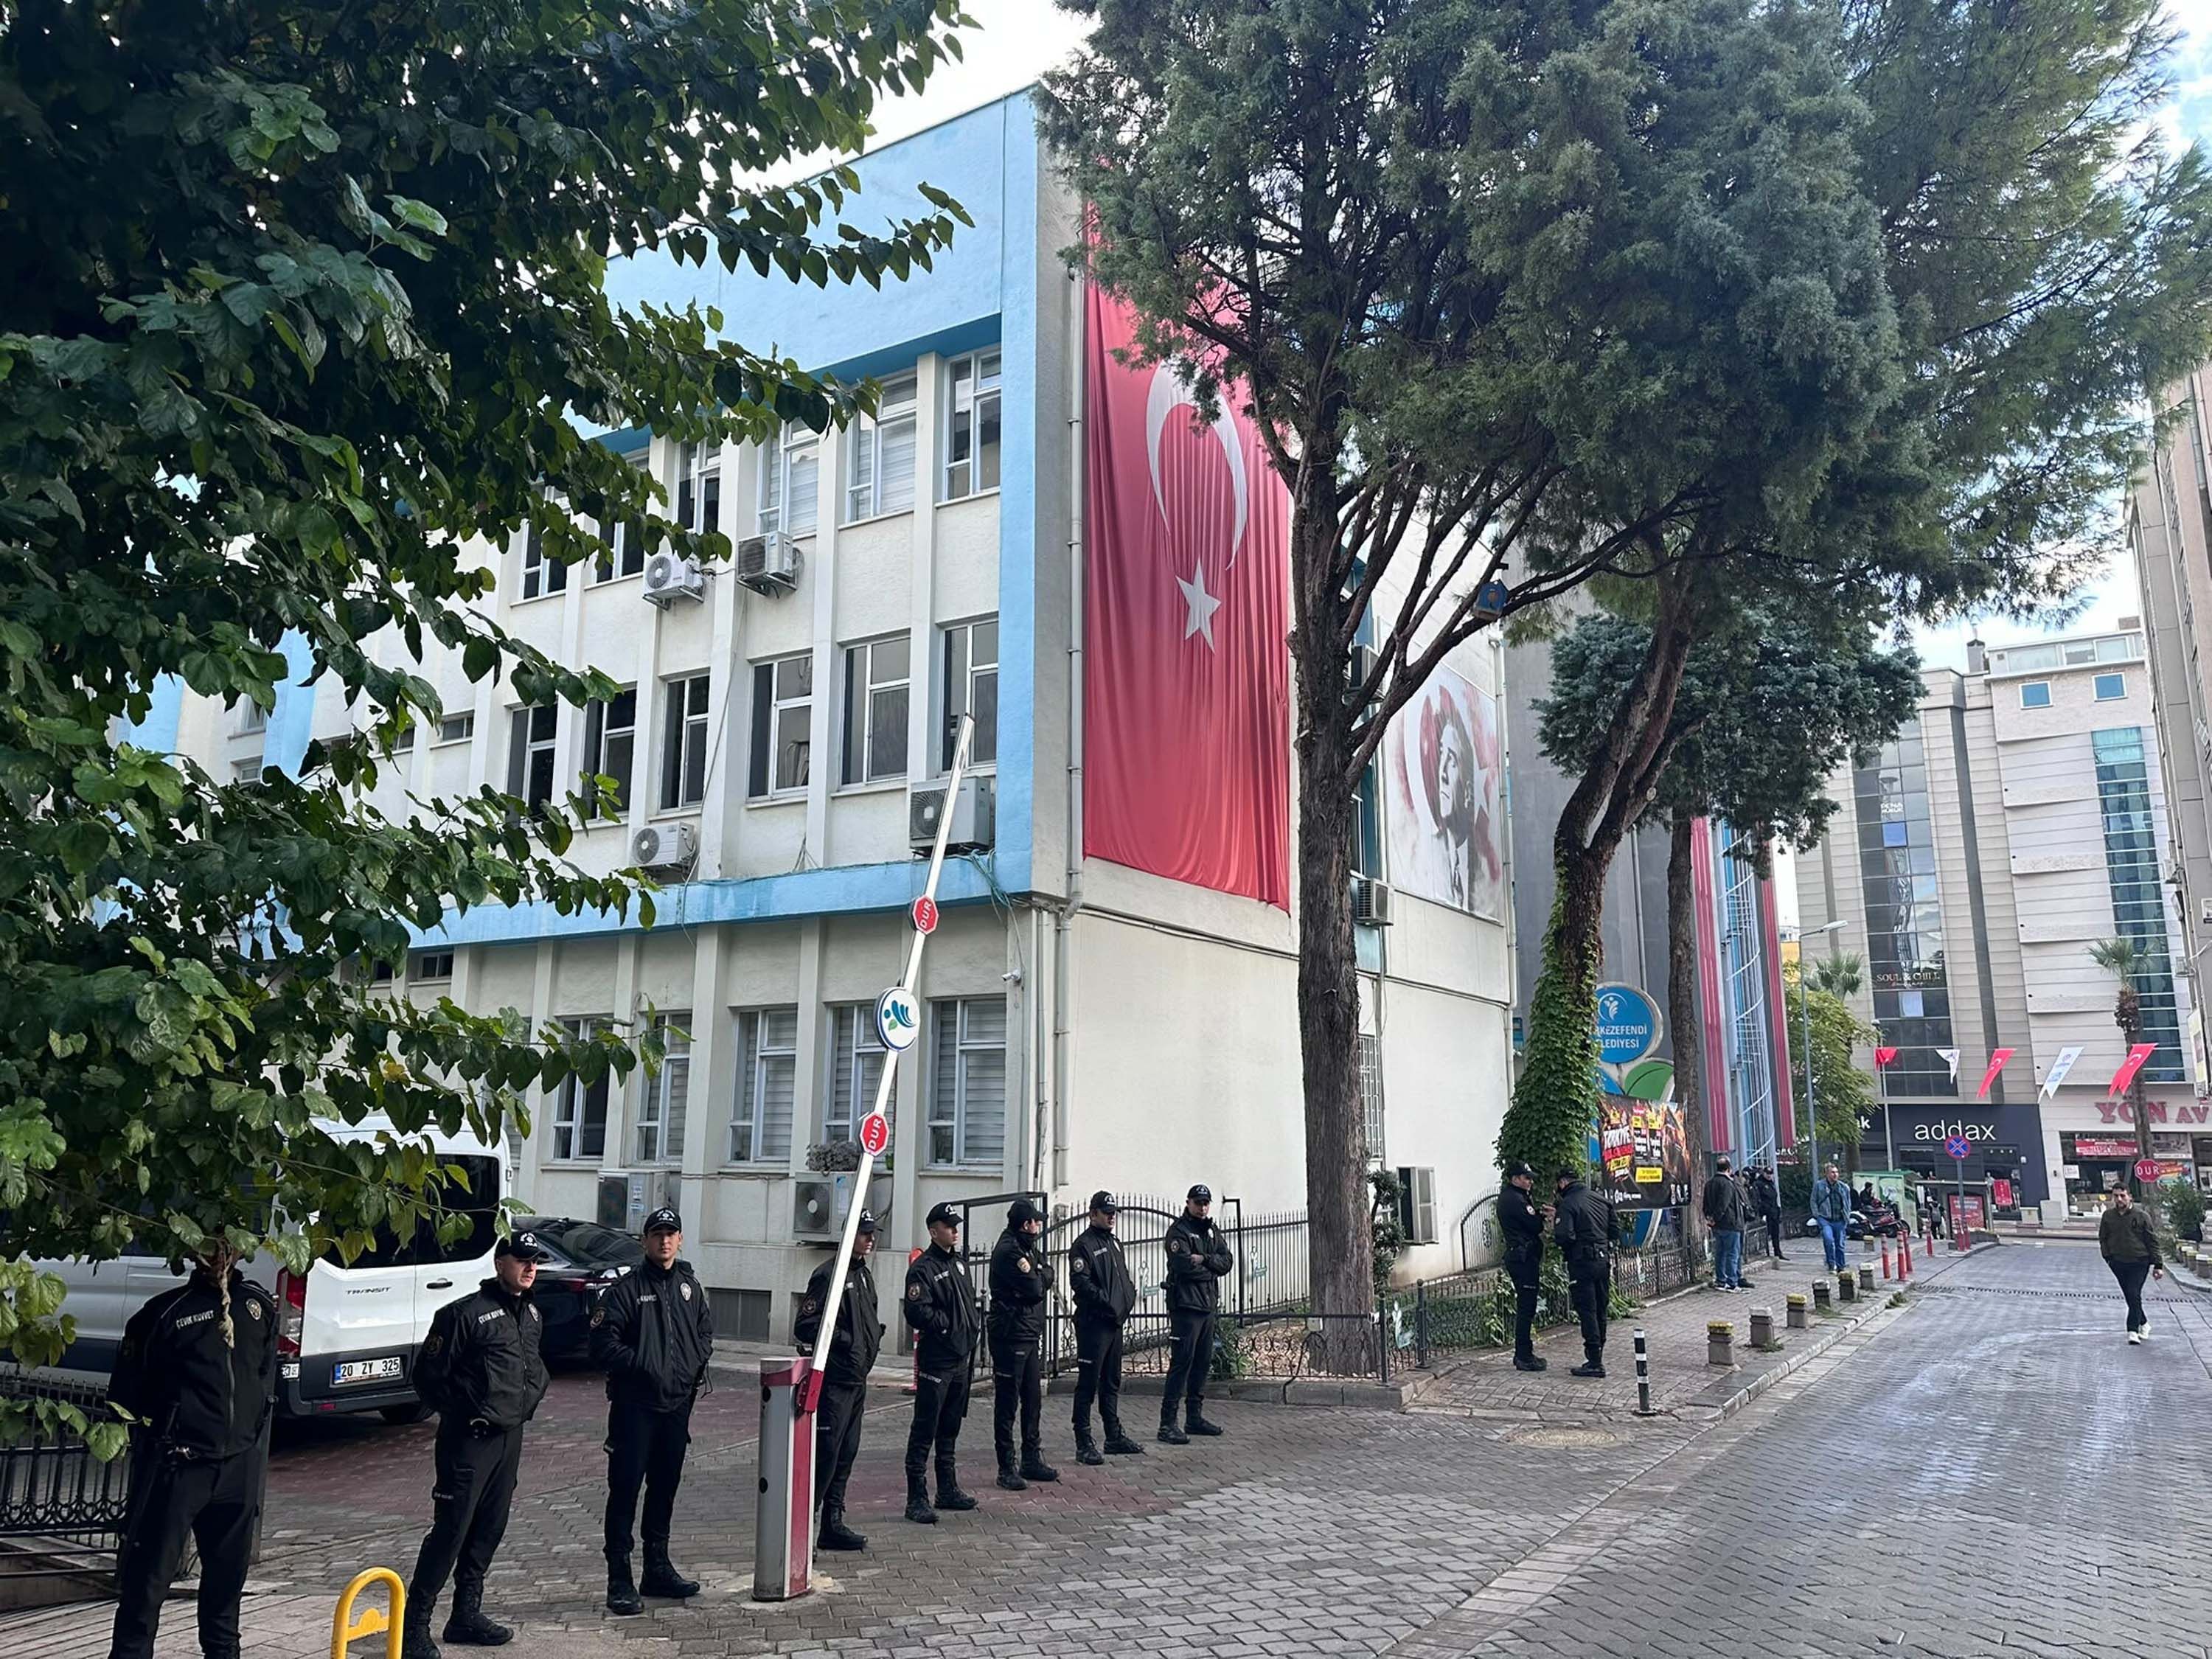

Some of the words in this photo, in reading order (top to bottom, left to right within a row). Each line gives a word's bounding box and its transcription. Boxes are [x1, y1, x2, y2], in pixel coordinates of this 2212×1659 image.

[919, 902, 932, 929] DUR
[869, 1118, 882, 1150] DUR
[1915, 1119, 1996, 1141] addax
[2138, 1165, 2160, 1176] DUR
[346, 1287, 392, 1295] TRANSIT
[341, 1365, 353, 1377] 20
[362, 1362, 374, 1374] ZY
[382, 1358, 399, 1371] 325
